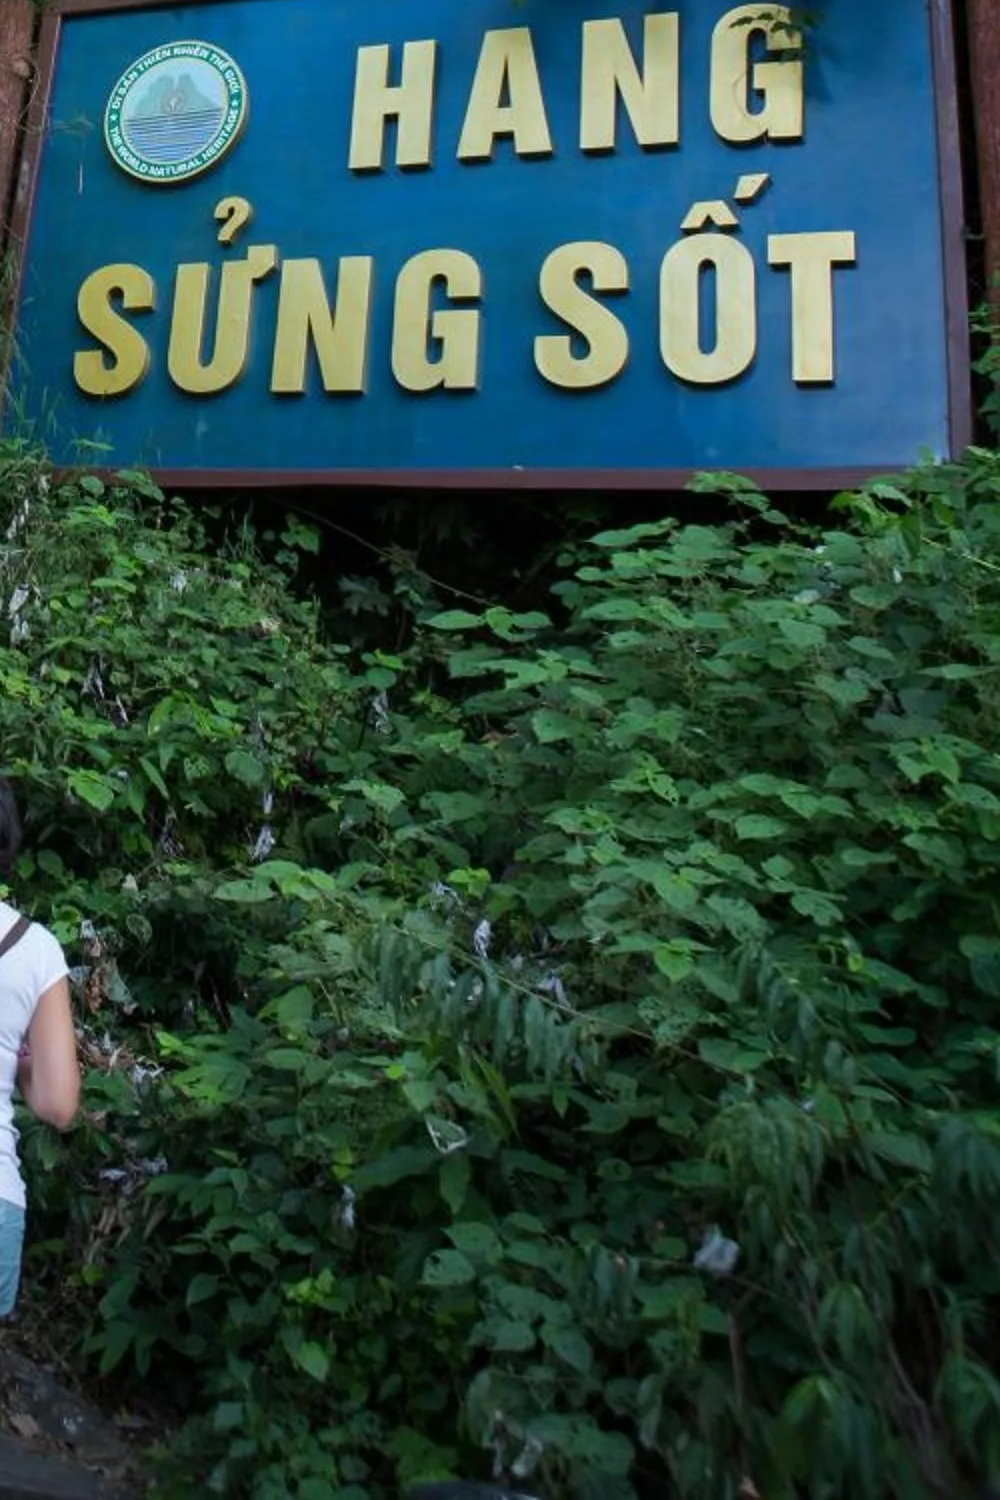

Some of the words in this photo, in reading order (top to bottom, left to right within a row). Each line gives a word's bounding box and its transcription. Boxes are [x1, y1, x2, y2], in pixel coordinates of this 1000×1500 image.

[148, 157, 202, 177] NATURAL
[348, 2, 804, 172] HANG
[73, 196, 483, 396] SỬNG
[533, 173, 856, 388] SỐT
